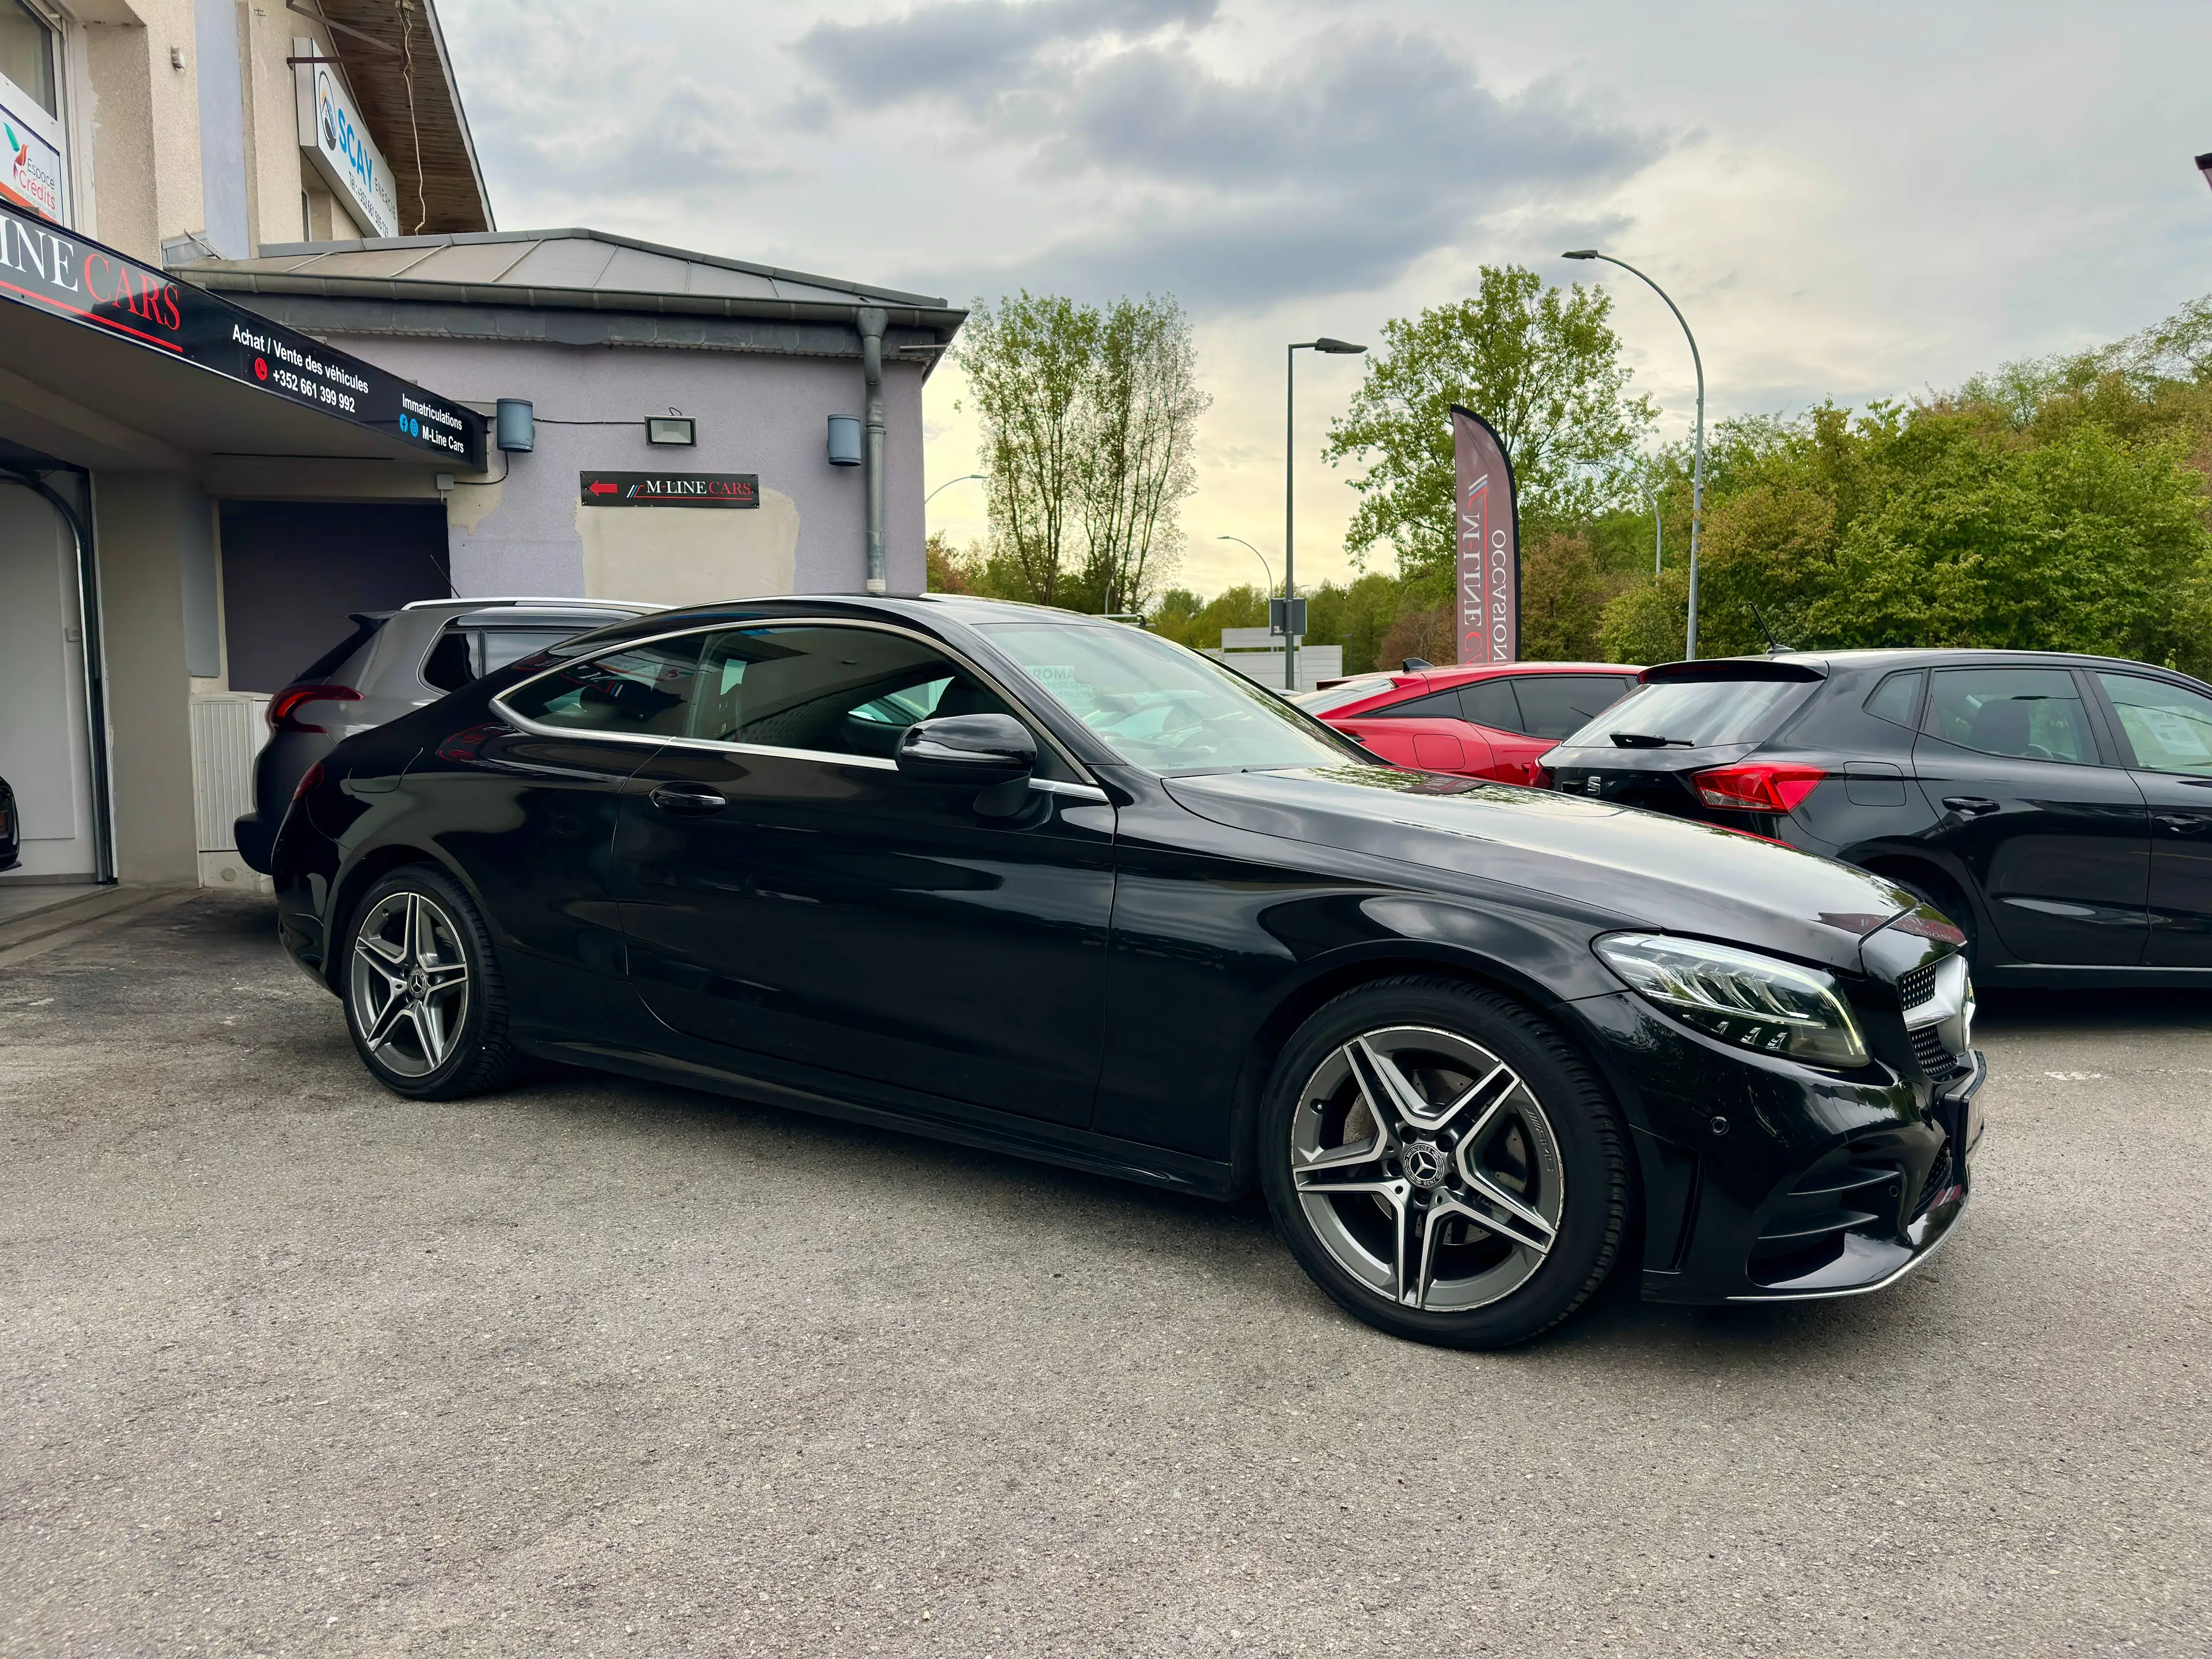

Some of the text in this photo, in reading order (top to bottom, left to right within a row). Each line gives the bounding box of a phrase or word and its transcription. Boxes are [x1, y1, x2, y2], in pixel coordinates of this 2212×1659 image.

[338, 108, 372, 194] SCAY
[19, 170, 55, 210] Crédits
[27, 157, 55, 190] Espace
[84, 253, 180, 330] CARS
[232, 324, 265, 352] Achat
[272, 340, 303, 367] Vente
[305, 355, 323, 375] des
[324, 365, 369, 393] véhicules
[273, 370, 355, 413] +352 661 399 992
[402, 393, 463, 430] Immatriculations
[422, 425, 464, 453] M-Line Cars
[646, 480, 751, 495] M-LINE CARS
[1406, 1146, 1431, 1158] MERCEDES
